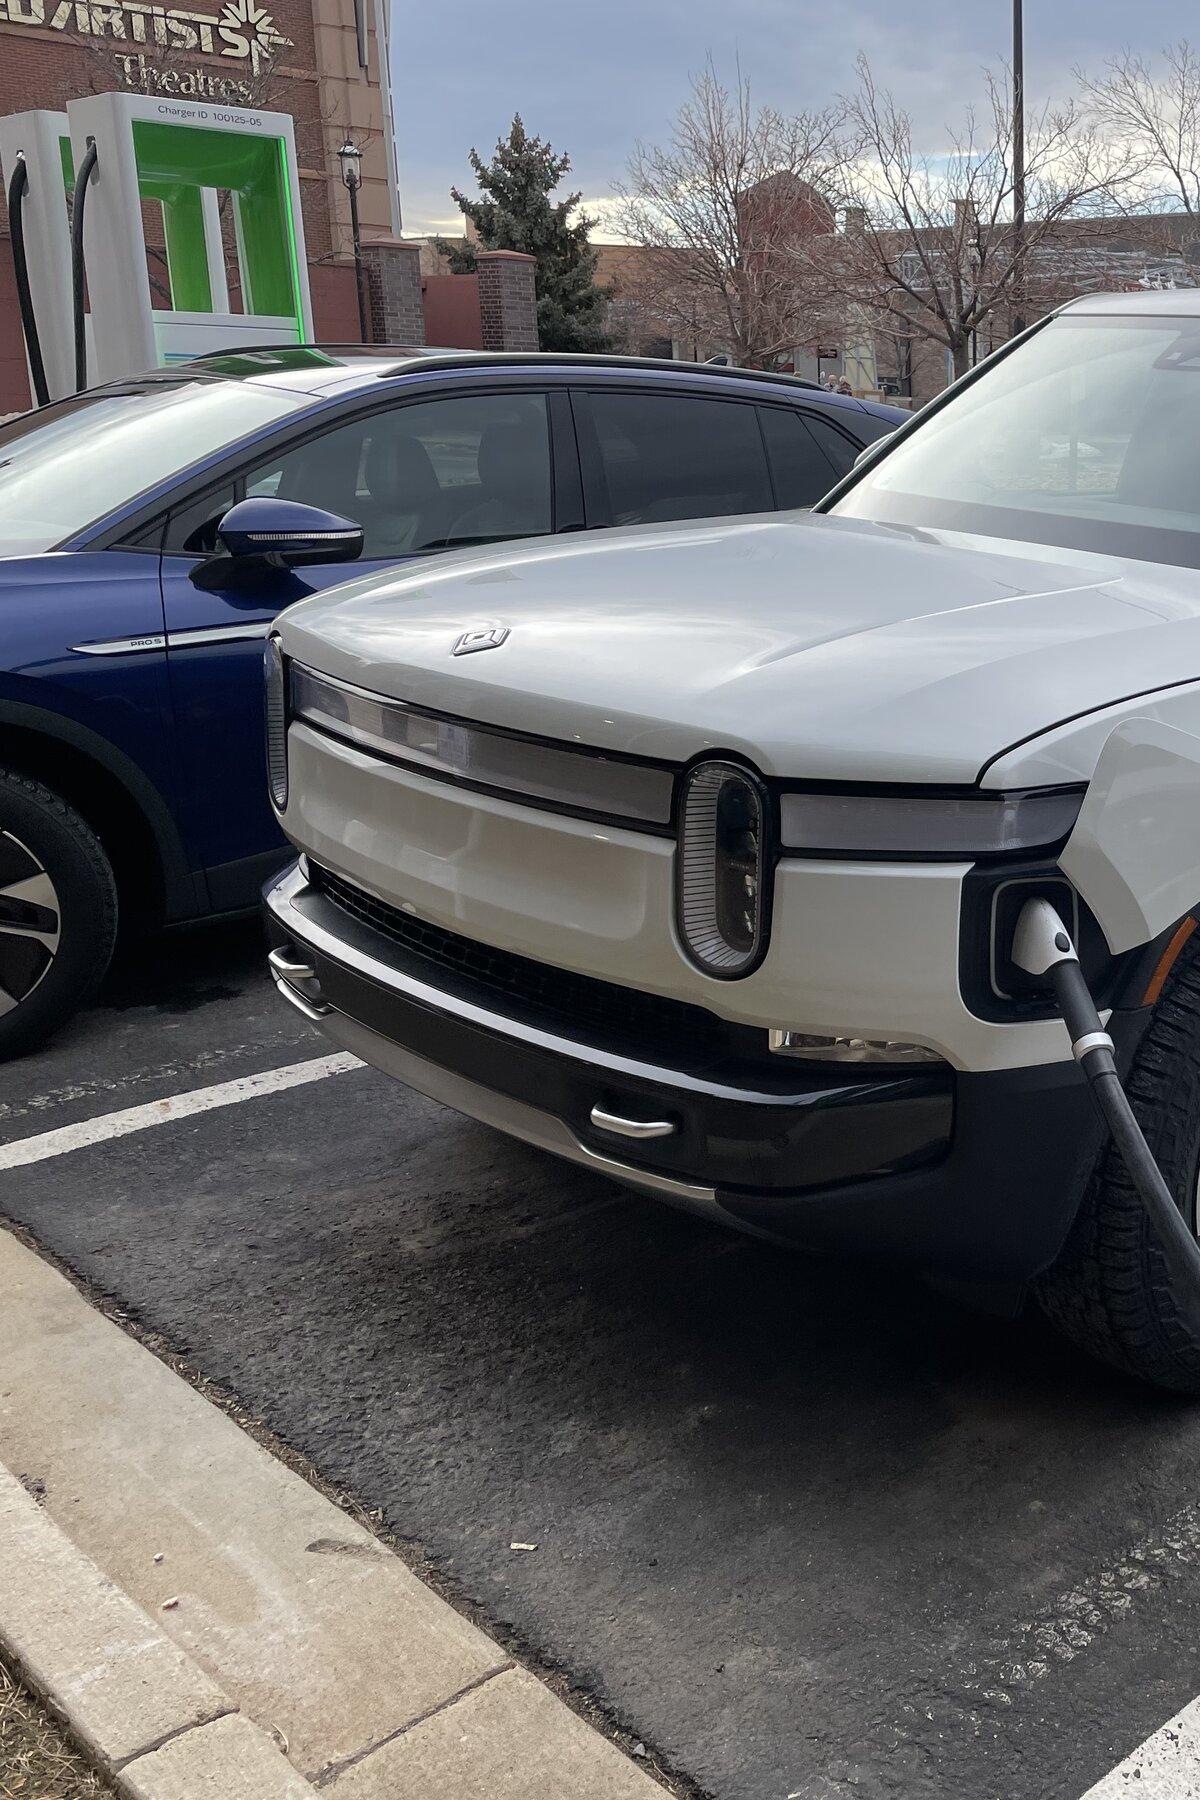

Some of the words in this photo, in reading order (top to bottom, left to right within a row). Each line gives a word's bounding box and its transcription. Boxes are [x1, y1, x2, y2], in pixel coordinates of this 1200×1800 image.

[114, 53, 252, 102] Theatres
[158, 105, 196, 118] Charger
[198, 110, 208, 119] ID
[213, 112, 262, 126] 100125-05
[130, 639, 153, 647] PRO
